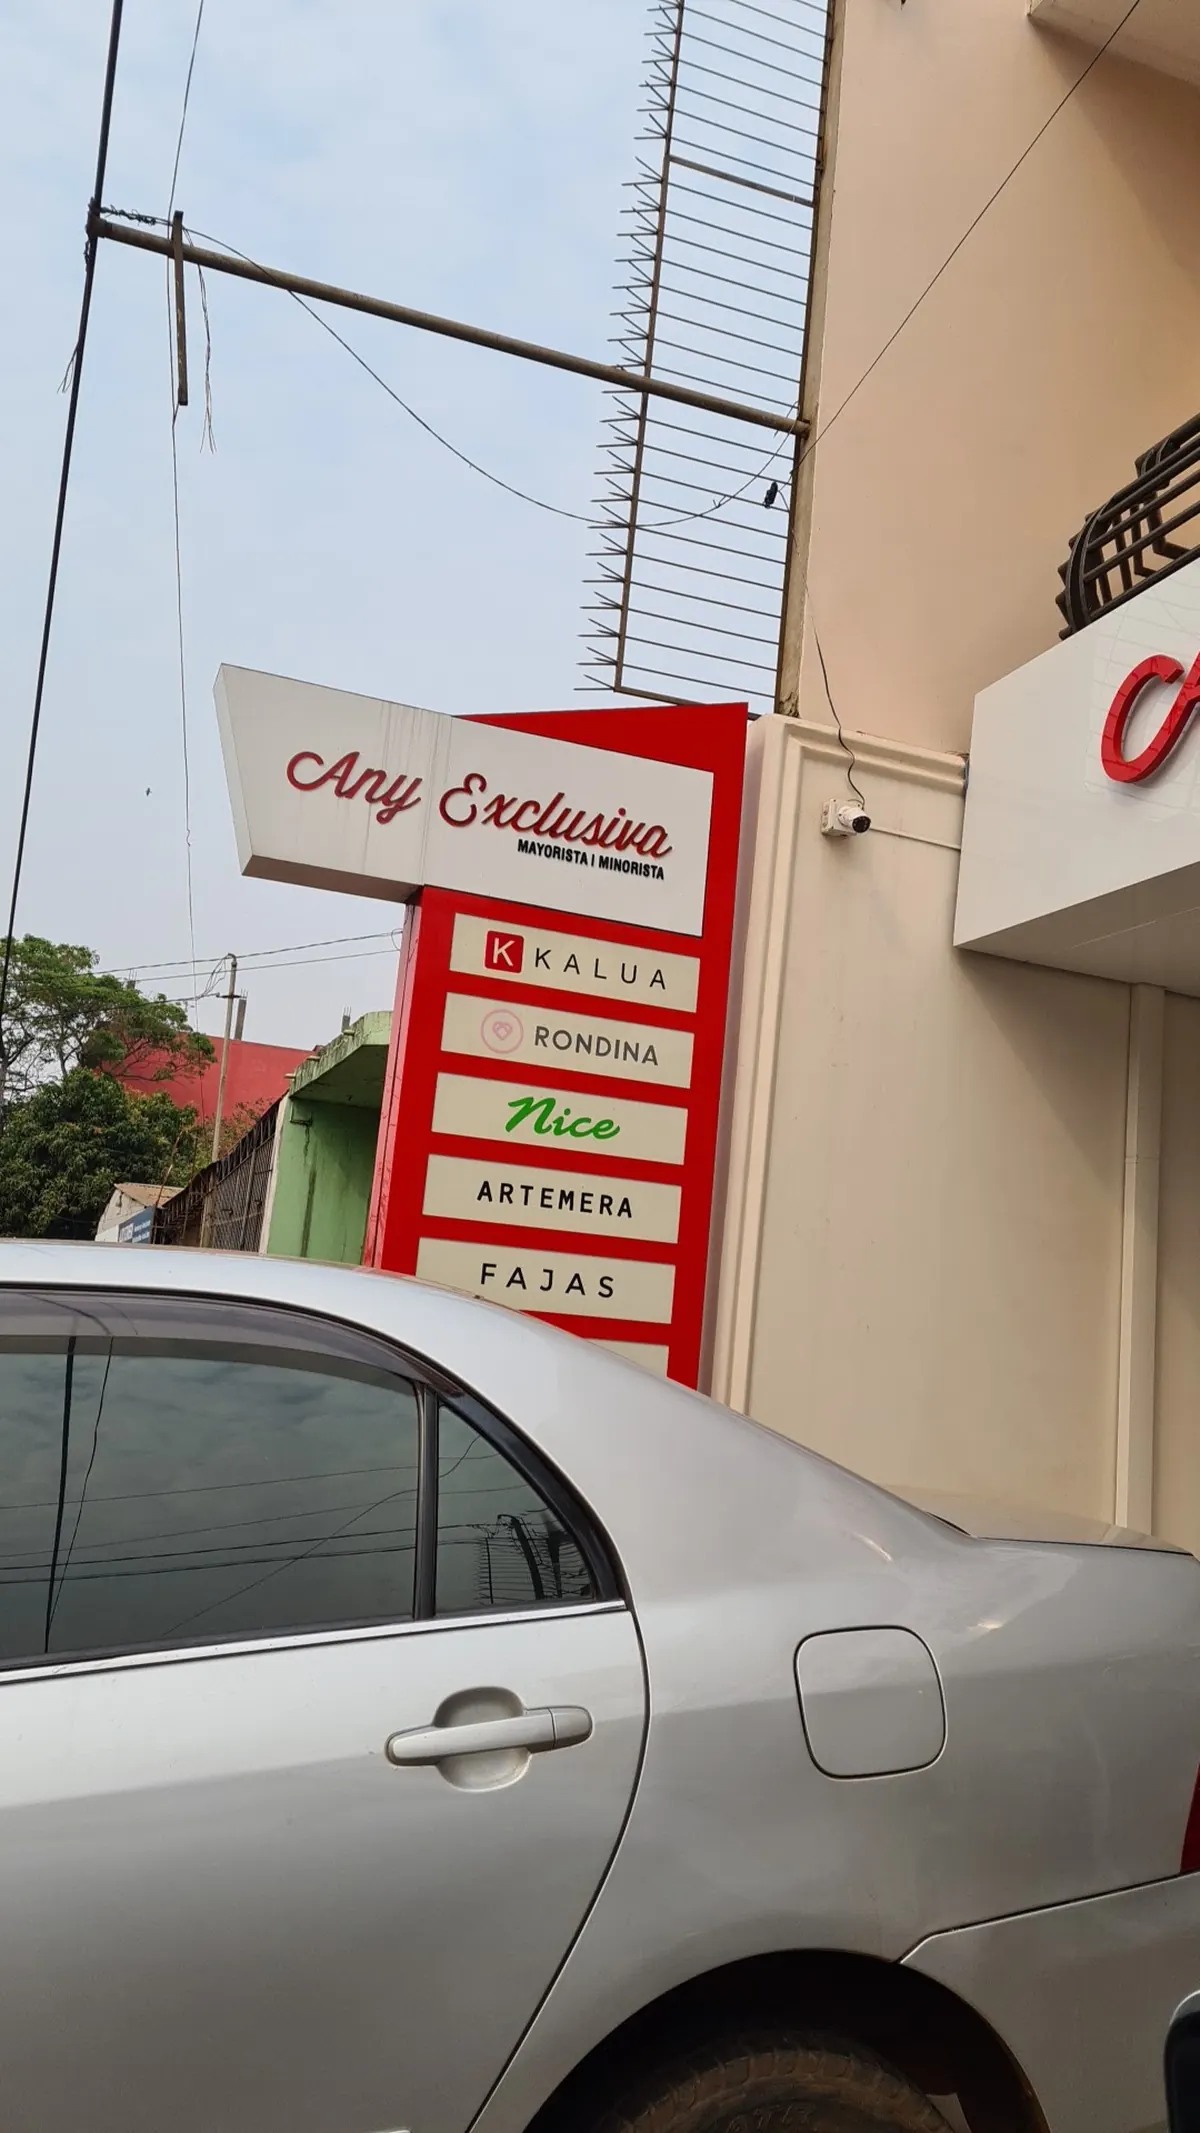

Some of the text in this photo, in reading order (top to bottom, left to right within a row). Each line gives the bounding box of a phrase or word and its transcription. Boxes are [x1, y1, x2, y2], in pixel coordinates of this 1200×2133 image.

[286, 750, 672, 858] Any Exclusiva
[517, 838, 588, 866] MAYORISTA
[598, 855, 664, 880] MINORISTA
[491, 938, 666, 990] K KALUA
[534, 1026, 659, 1066] RONDINA
[505, 1096, 620, 1140] Nice
[477, 1180, 633, 1219] ARTEMERA
[480, 1263, 614, 1298] FAJAS
